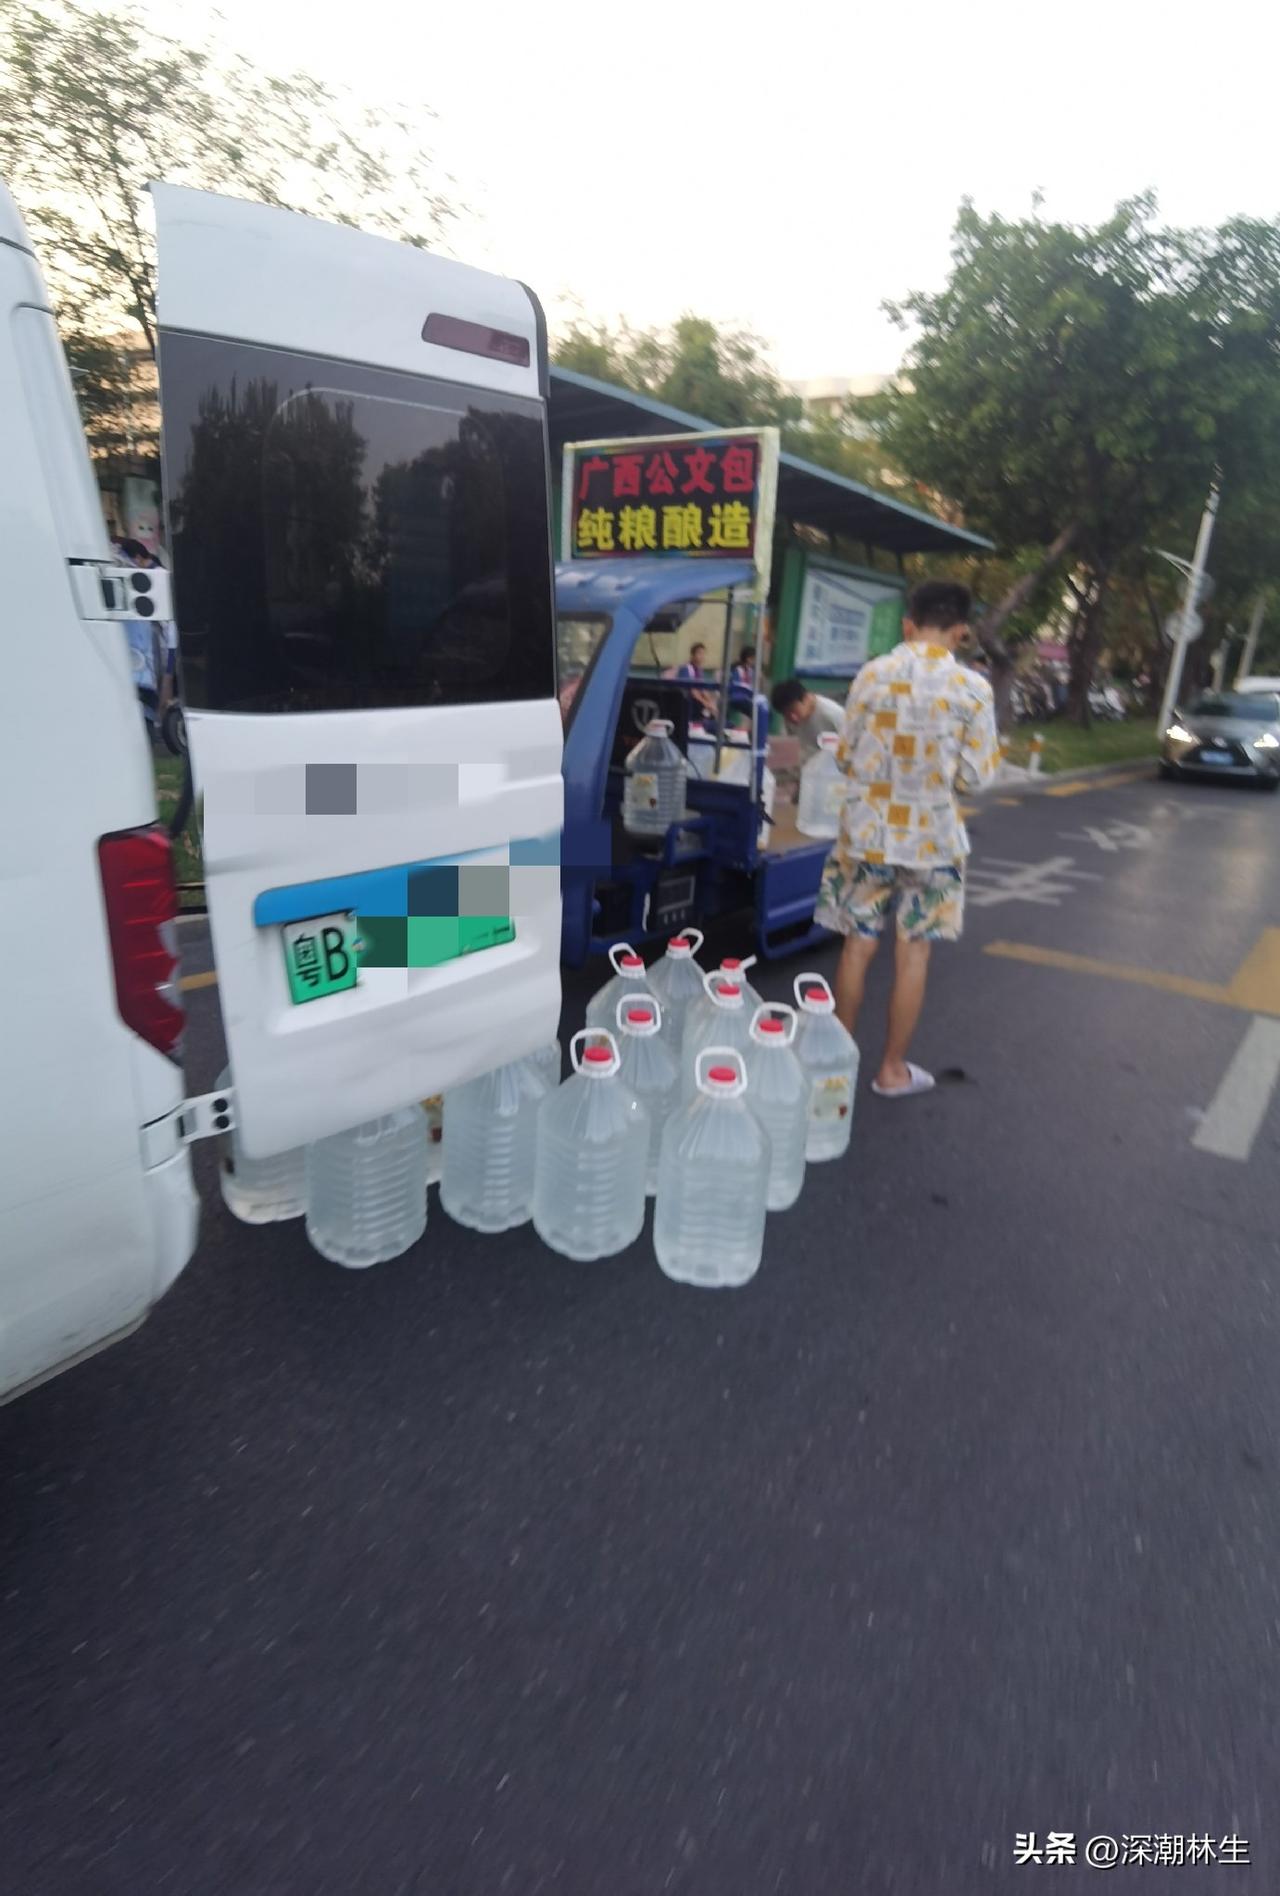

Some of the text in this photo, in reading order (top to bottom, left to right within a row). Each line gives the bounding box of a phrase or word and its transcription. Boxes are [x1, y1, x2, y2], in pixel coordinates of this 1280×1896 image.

[578, 446, 754, 500] 广西公文包
[577, 501, 750, 550] 纯粮酿造
